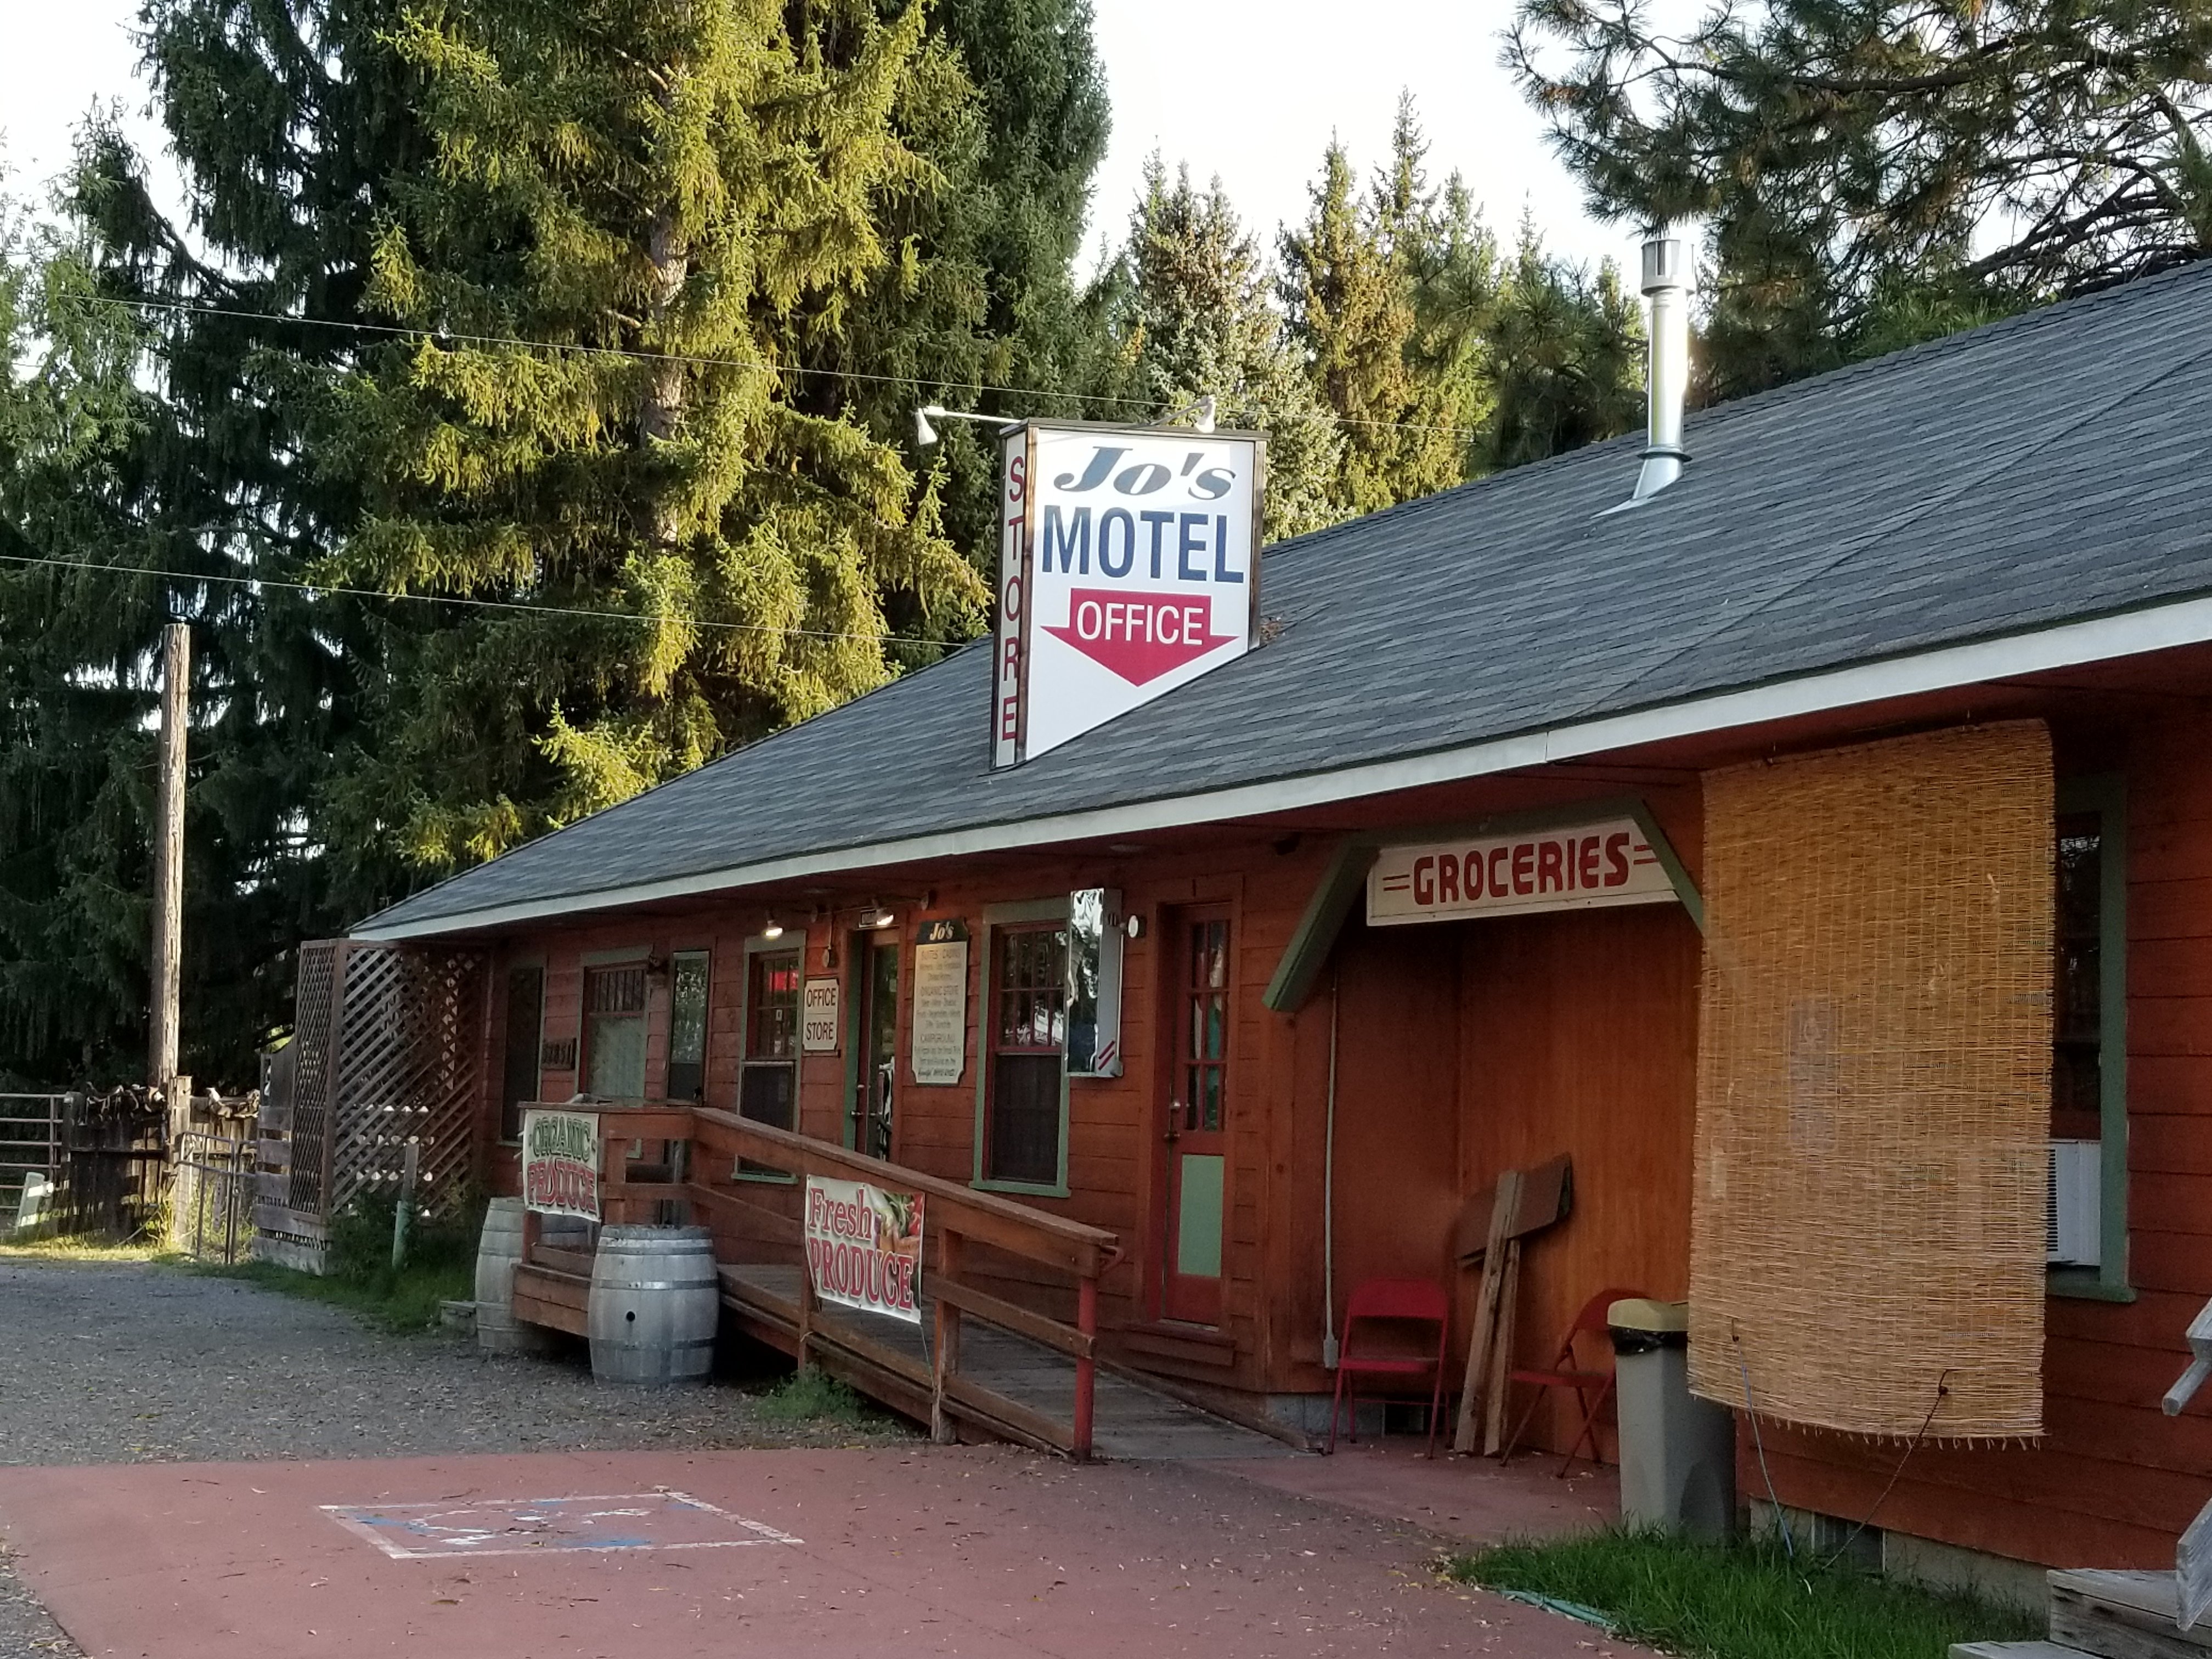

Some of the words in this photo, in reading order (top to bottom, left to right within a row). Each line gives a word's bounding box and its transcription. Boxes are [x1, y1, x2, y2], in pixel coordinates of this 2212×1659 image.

[1053, 445, 1237, 500] Jo's
[1042, 505, 1244, 584] MOTEL
[1002, 455, 1025, 741] STORE
[1076, 601, 1204, 645] OFFICE
[1413, 832, 1630, 905] GROCERIES
[929, 921, 954, 940] Jo's
[806, 988, 836, 1007] OFFICE
[806, 1022, 834, 1040] STORE
[532, 1116, 591, 1163] ORGANIC
[527, 1158, 597, 1216] PRODUCE
[808, 1187, 873, 1241] Fresh
[808, 1236, 914, 1311] PRODUCE
